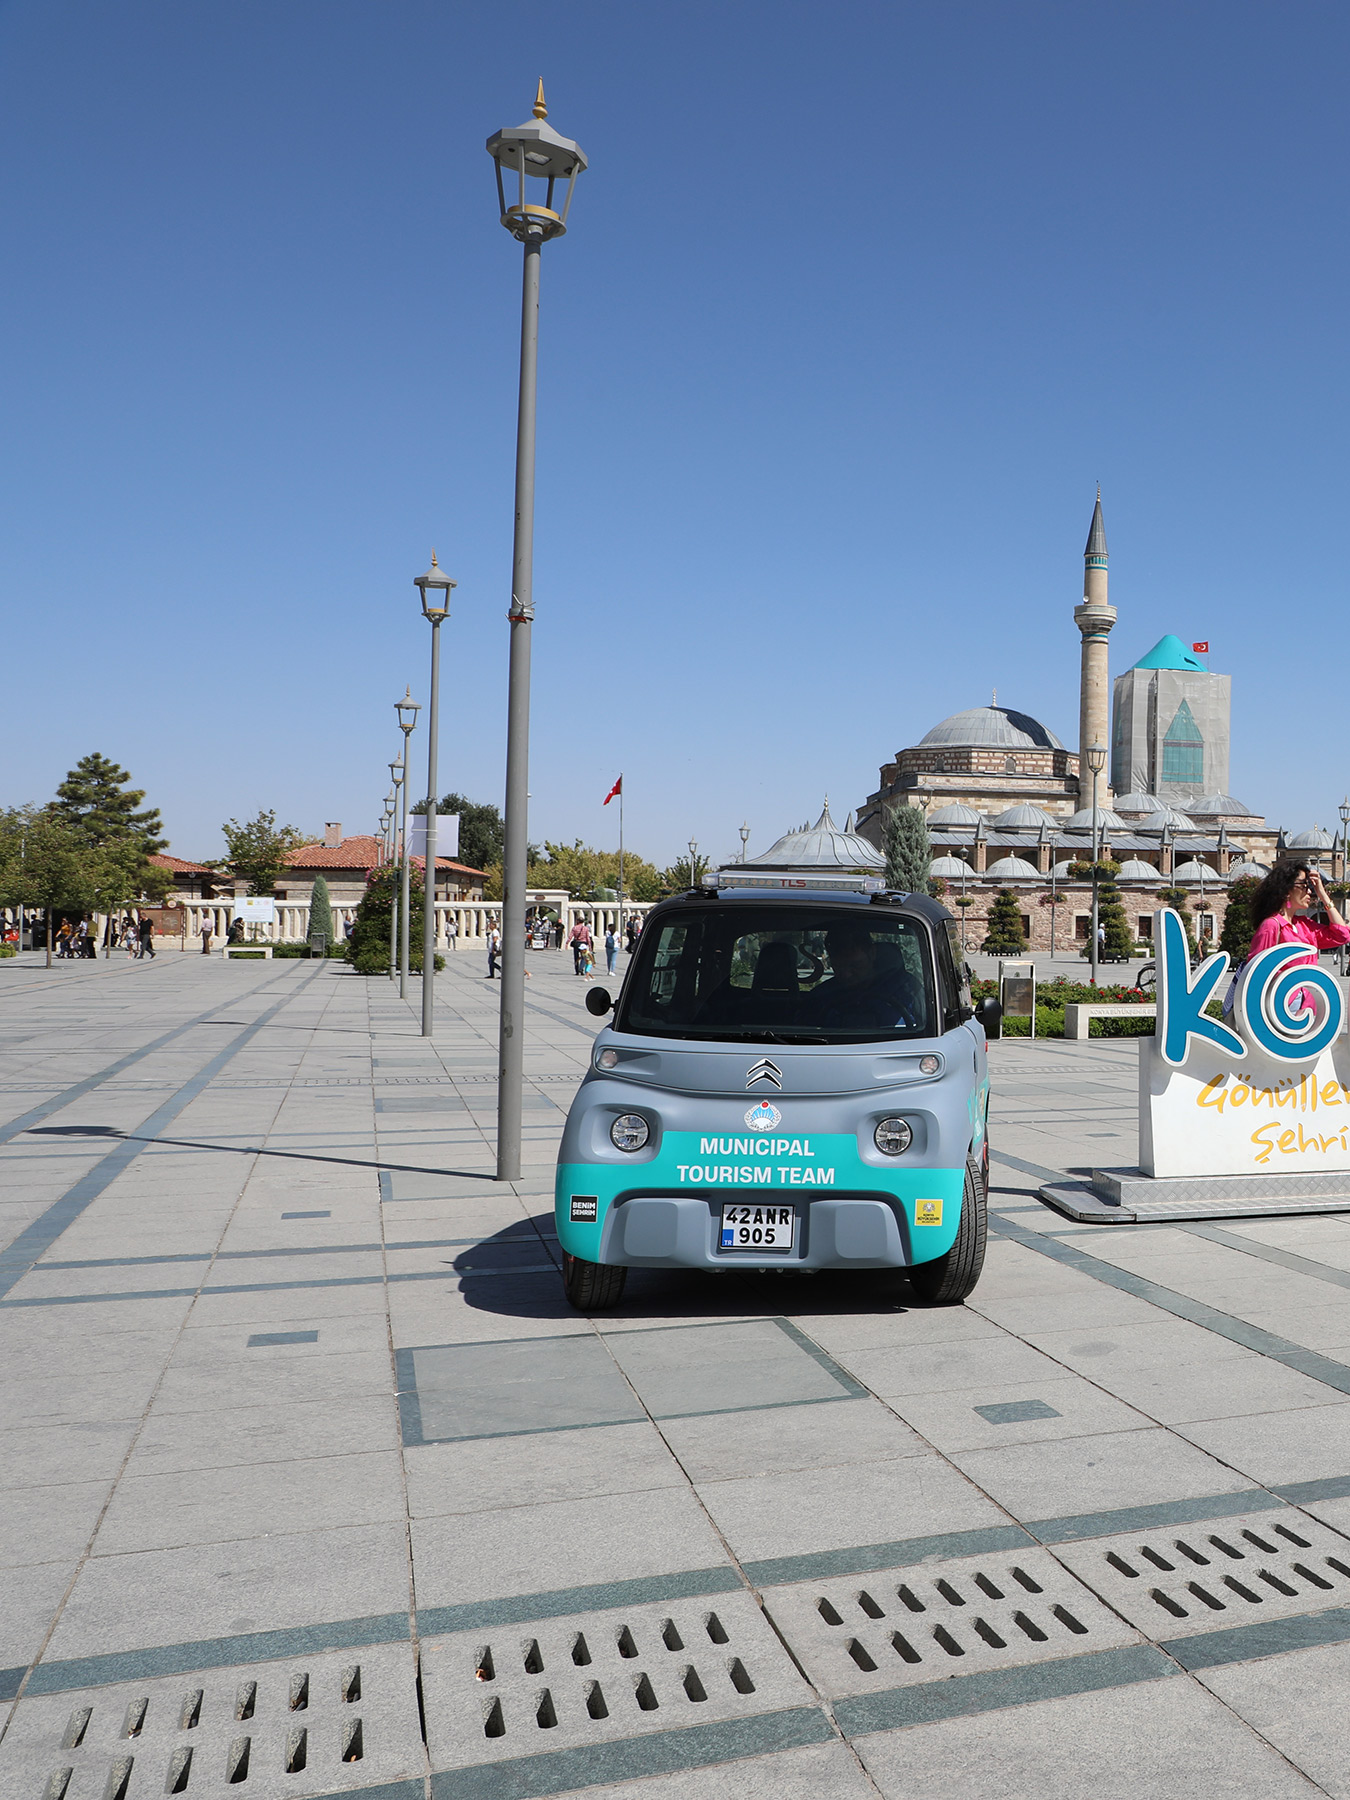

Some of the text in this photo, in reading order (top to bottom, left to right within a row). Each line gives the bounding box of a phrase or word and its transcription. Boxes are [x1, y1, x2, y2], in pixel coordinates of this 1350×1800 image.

[780, 879, 806, 887] TLS
[700, 1137, 815, 1157] MUNICIPAL
[1250, 1121, 1349, 1164] Şehri
[676, 1165, 835, 1185] TOURISM TEAM
[726, 1207, 790, 1225] 42ANR
[739, 1227, 776, 1244] 905
